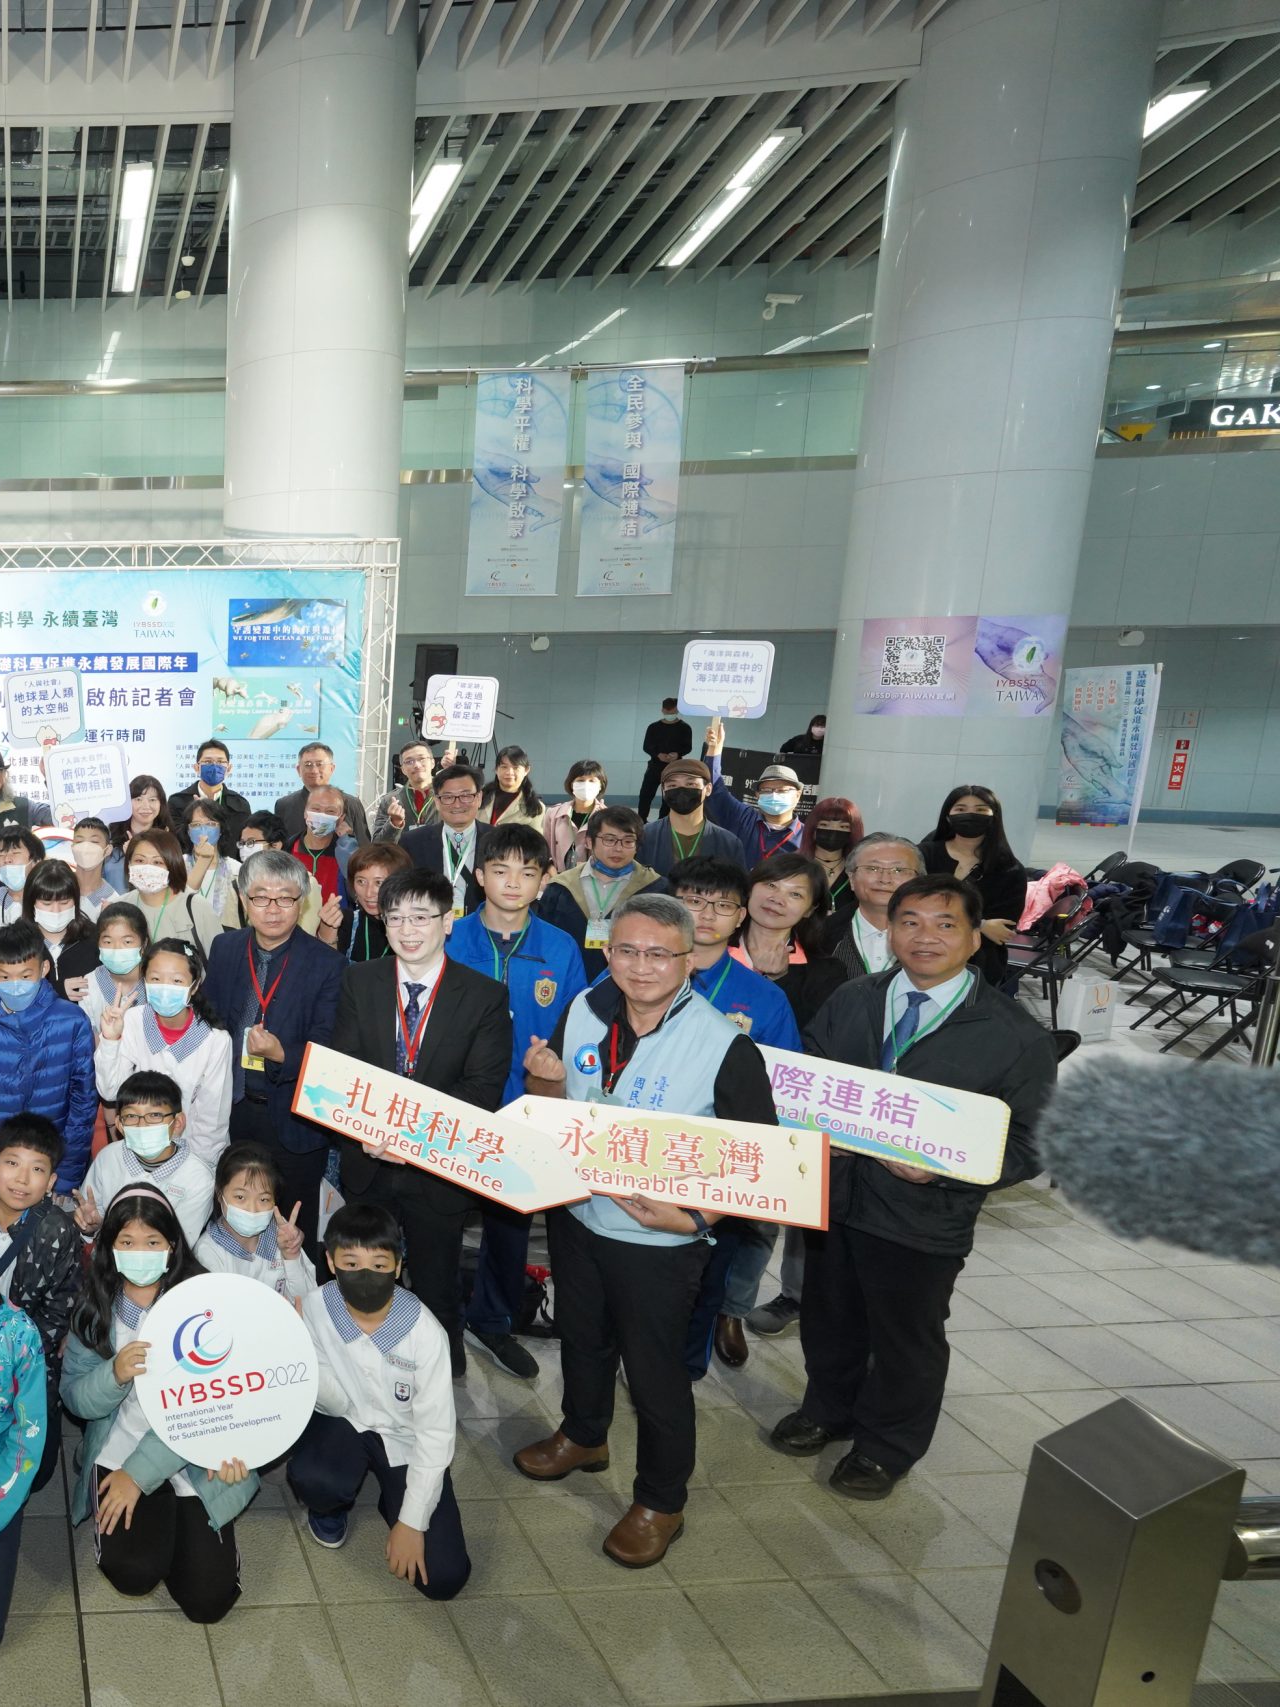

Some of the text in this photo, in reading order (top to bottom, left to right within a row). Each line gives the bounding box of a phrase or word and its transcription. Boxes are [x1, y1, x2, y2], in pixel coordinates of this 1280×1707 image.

[511, 376, 533, 452] 科學平權
[624, 374, 646, 449] 全民參與
[506, 463, 528, 539] 科學啟蒙
[42, 609, 120, 628] 永續臺灣
[134, 628, 176, 639] TAIWAN
[696, 673, 755, 685] 海洋與森林
[996, 679, 1037, 688] IYBSSD
[14, 687, 75, 704] 地球是人類
[21, 702, 70, 717] 的太空船
[84, 728, 147, 743] 運行時間
[61, 763, 112, 780] 俯仰之間
[63, 778, 113, 795] 萬物相惜
[626, 1076, 646, 1108] 國民
[649, 1075, 670, 1110] 臺北
[346, 1077, 506, 1164] 扎根科學
[332, 1108, 503, 1192] Grounded Science
[558, 1118, 764, 1183] 永續臺灣
[814, 1112, 968, 1164] Connections
[697, 1182, 788, 1212] Taiwan
[160, 1362, 311, 1410] IYBSSD2022
[165, 1402, 234, 1422] International Year
[167, 1413, 234, 1432] of Basic Sciences
[169, 1413, 282, 1442] for Sustainable Development
